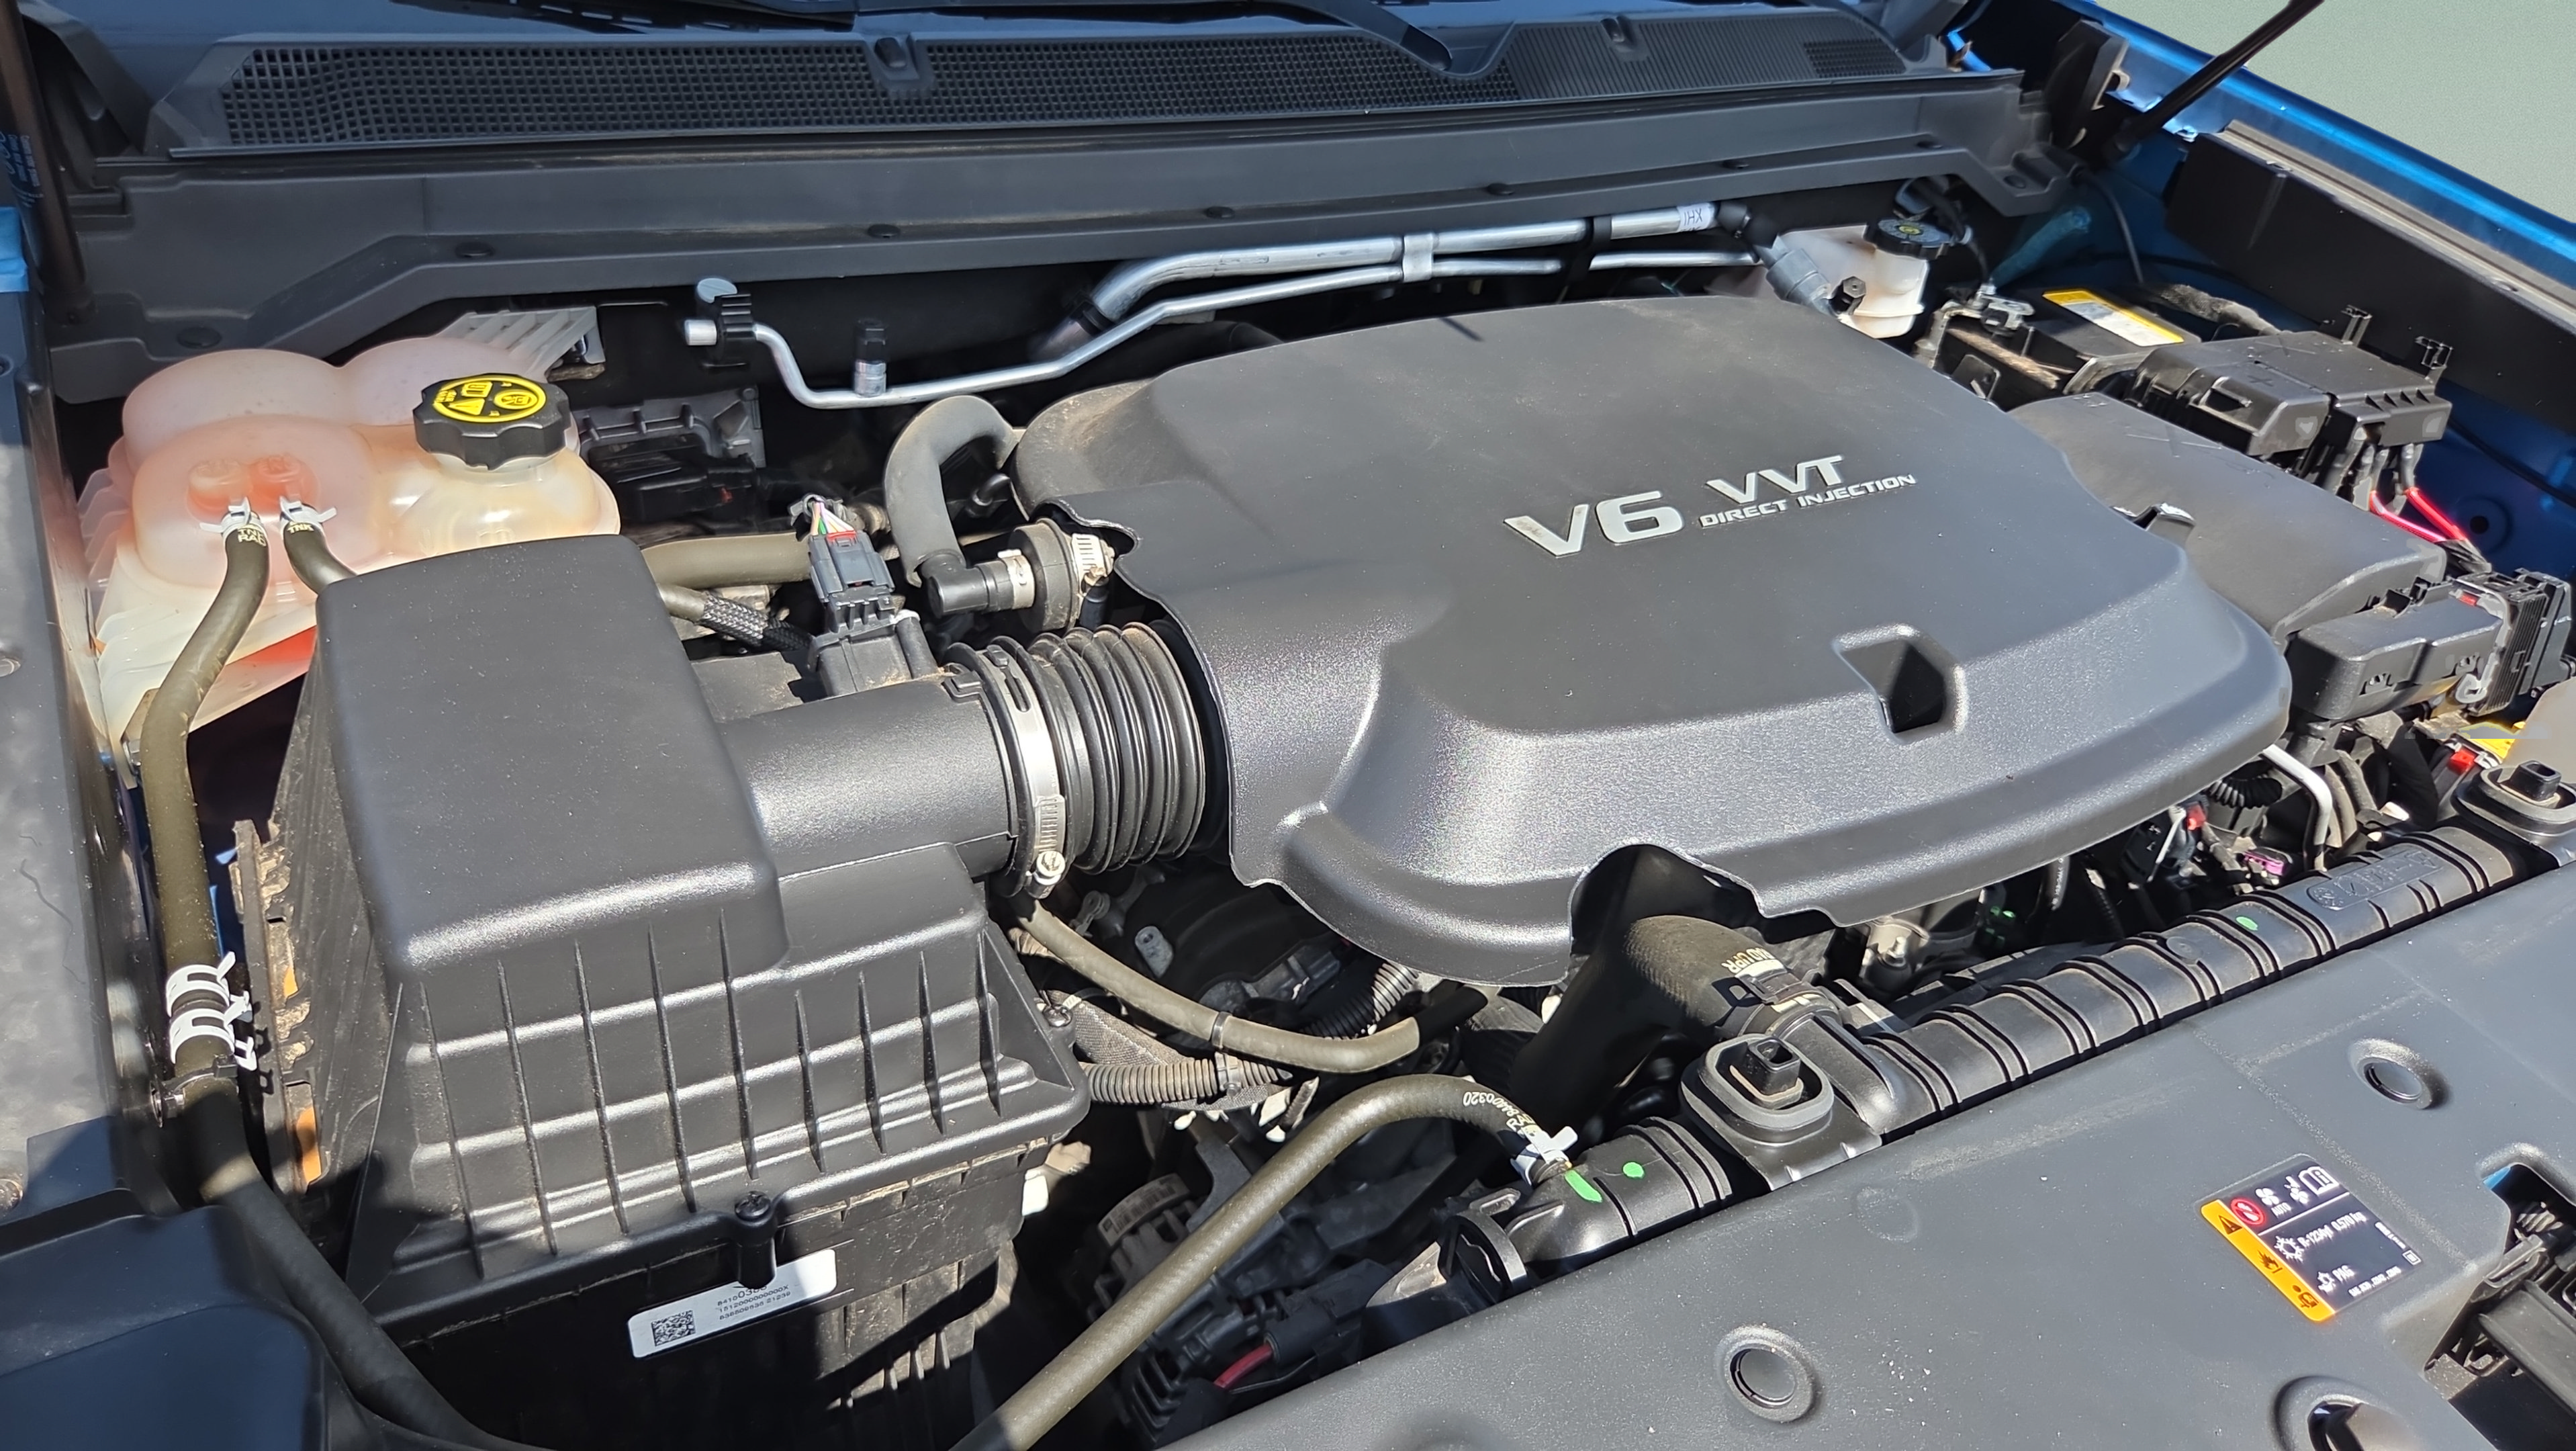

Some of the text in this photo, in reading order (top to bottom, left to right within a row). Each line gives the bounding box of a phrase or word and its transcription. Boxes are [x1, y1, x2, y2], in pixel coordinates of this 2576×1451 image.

[1705, 454, 1844, 504] VVT
[1700, 474, 1917, 529] DIRECT INJECTION
[1504, 490, 1684, 558] V6
[1721, 952, 1755, 974] UPR
[1463, 1091, 1520, 1117] 84400320
[2270, 1202, 2292, 1219] AUTO
[2297, 1211, 2367, 1249] R-1234yf 0.570 kg
[2332, 1265, 2355, 1282] PAG
